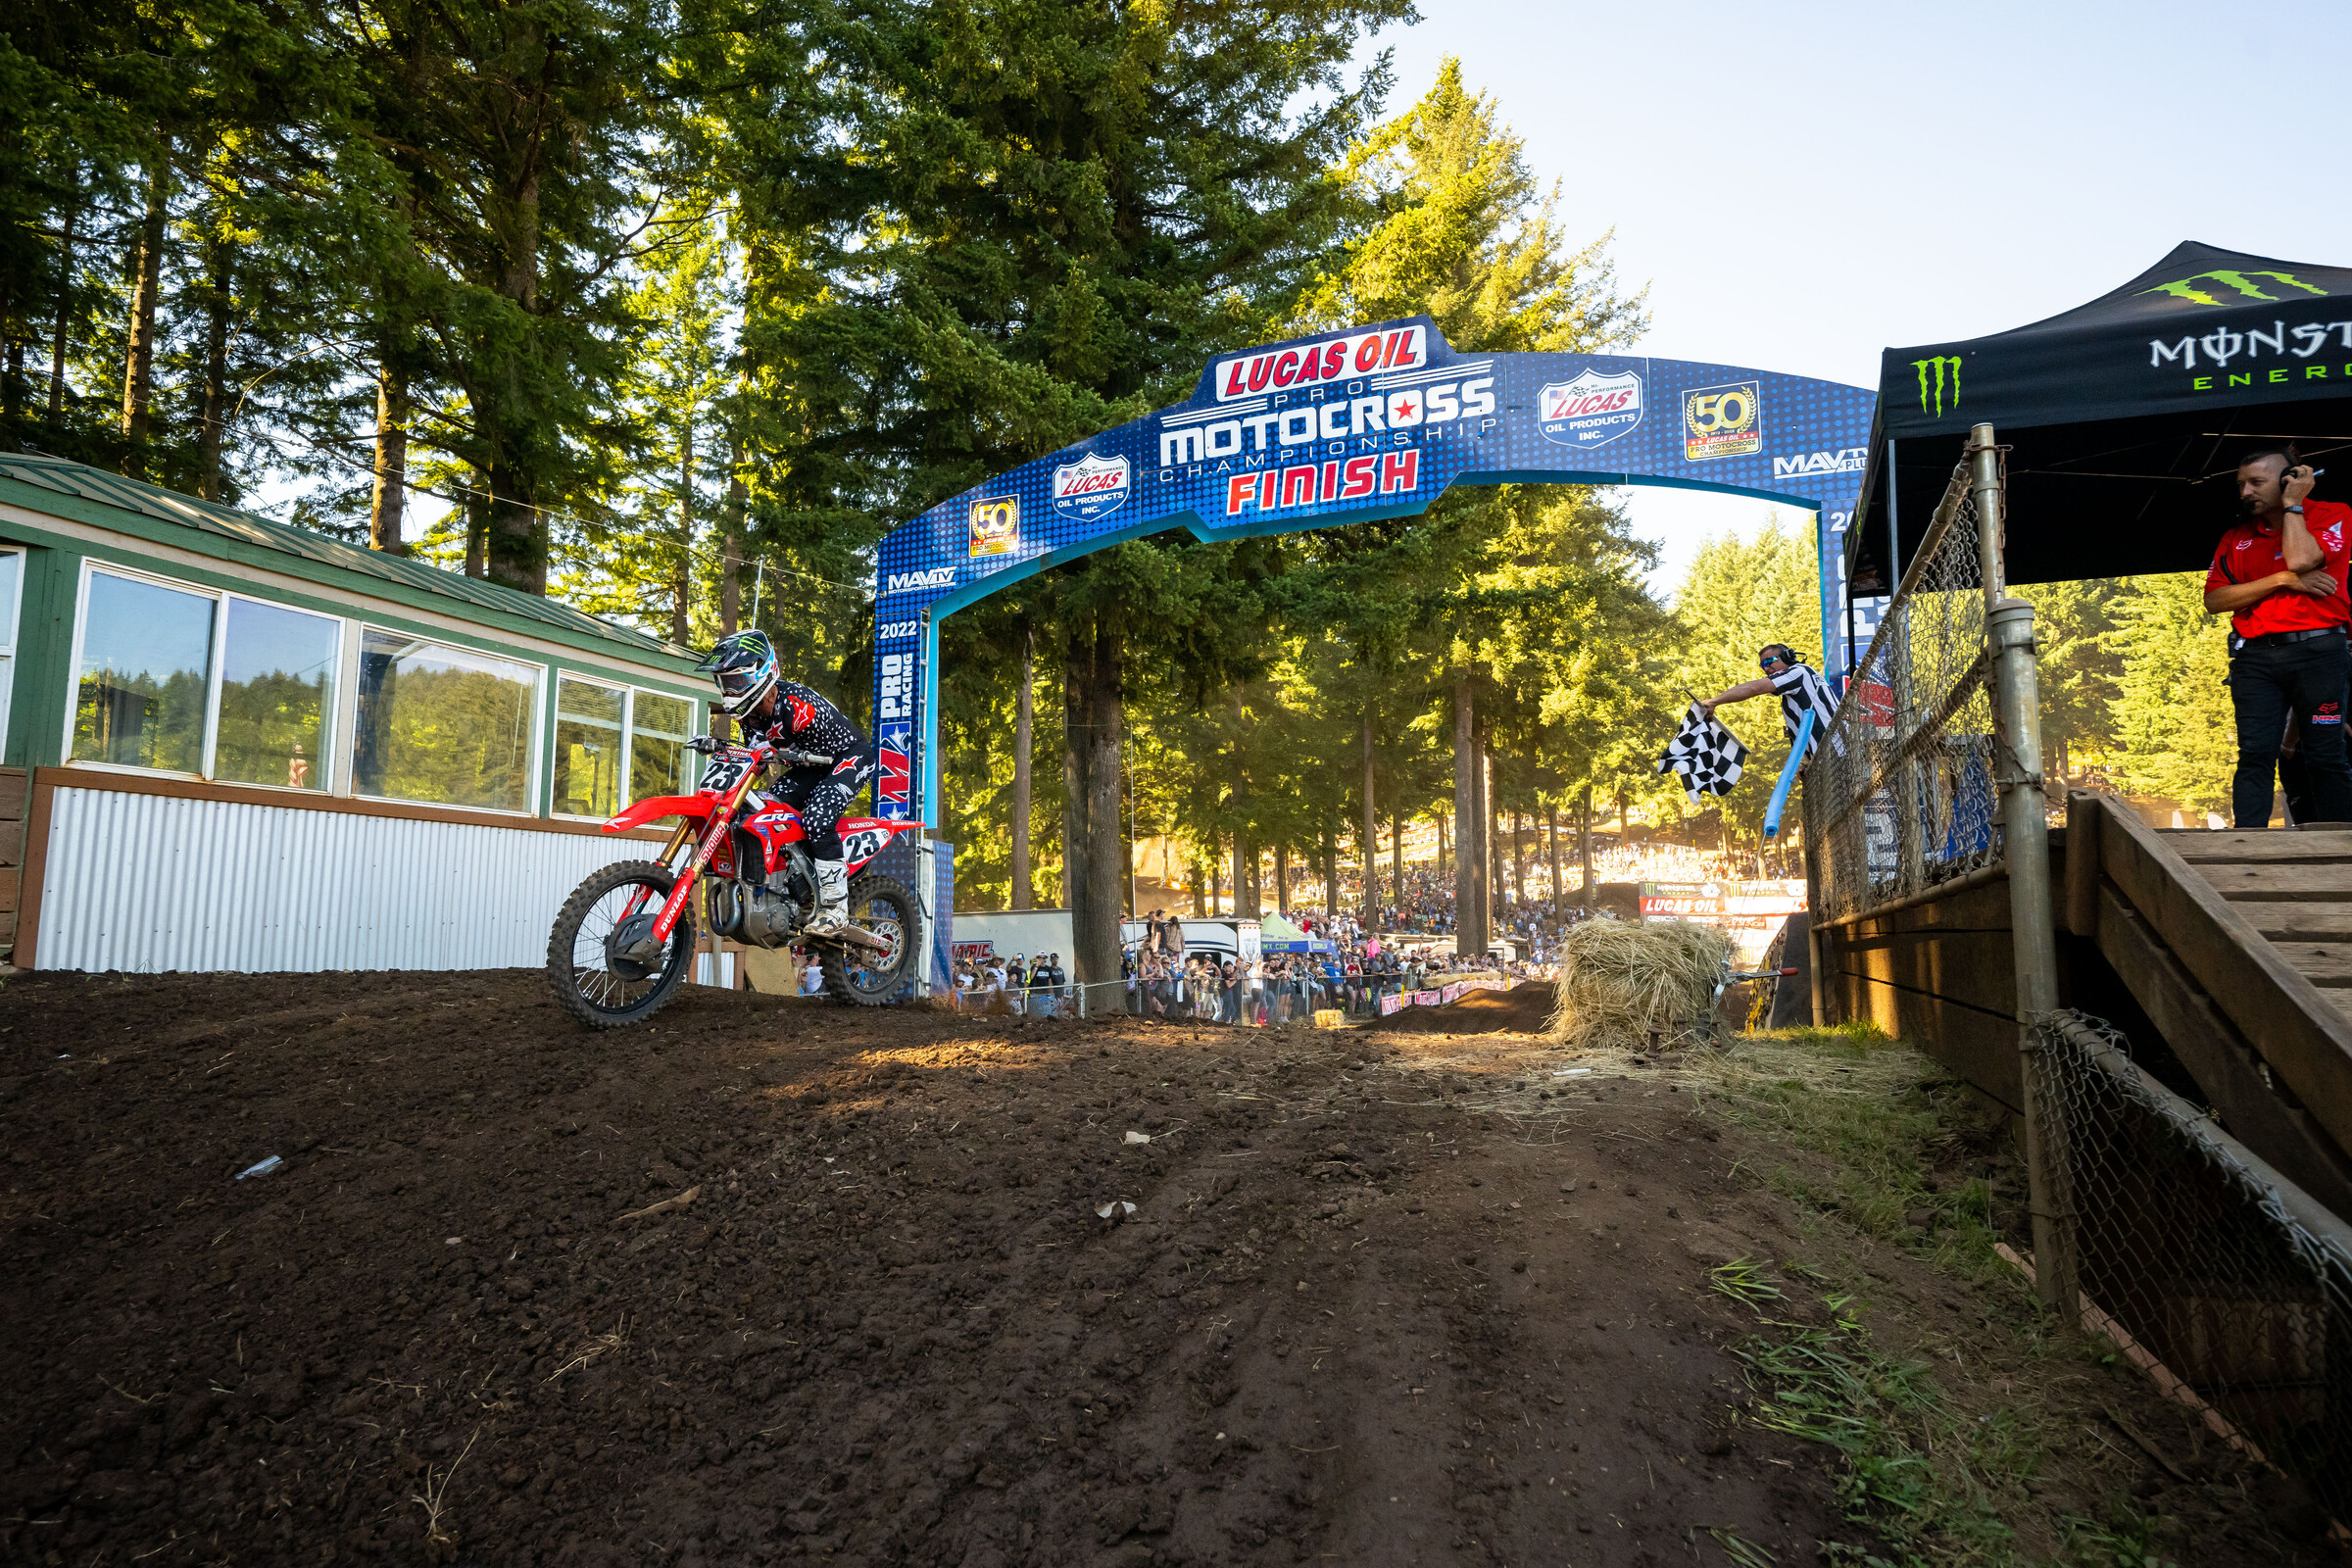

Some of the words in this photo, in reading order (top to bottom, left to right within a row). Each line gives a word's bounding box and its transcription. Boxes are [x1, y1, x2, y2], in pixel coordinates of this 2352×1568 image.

[2149, 319, 2352, 369] MONST
[1225, 341, 1347, 397] LUCAS
[1355, 329, 1415, 373] OIL
[1275, 381, 1363, 408] PRO
[1592, 383, 1635, 394] PERFORMANCE
[1550, 390, 1633, 418] LUCAS
[1695, 392, 1751, 432] 50
[1159, 377, 1495, 466] MOTOCROSS
[1545, 423, 1566, 433] OIL
[1569, 414, 1636, 430] PRODUCTS
[1579, 430, 1604, 441] INC.
[1159, 418, 1497, 482] CHAMPIONSHIP
[1699, 447, 1747, 457] CHAMPIONSHIP
[1708, 439, 1756, 451] MOTOCROSS
[1845, 459, 1867, 470] PLU
[1061, 471, 1123, 496] LUCAS
[1226, 449, 1420, 516] FINISH
[1057, 499, 1072, 508] OIL
[1075, 491, 1124, 505] PRODUCTS
[1081, 506, 1101, 514] INC.
[978, 502, 1014, 535] 50
[879, 620, 917, 640] 2022
[880, 654, 903, 719] PRO
[901, 653, 913, 717] RACING
[700, 761, 744, 791] 23
[753, 812, 796, 823] CRF
[700, 823, 726, 863] SHOWA
[846, 831, 881, 864] 23
[660, 885, 688, 933] DUNLOP
[1645, 899, 1692, 913] LUCAS
[1694, 899, 1718, 912] OIL
